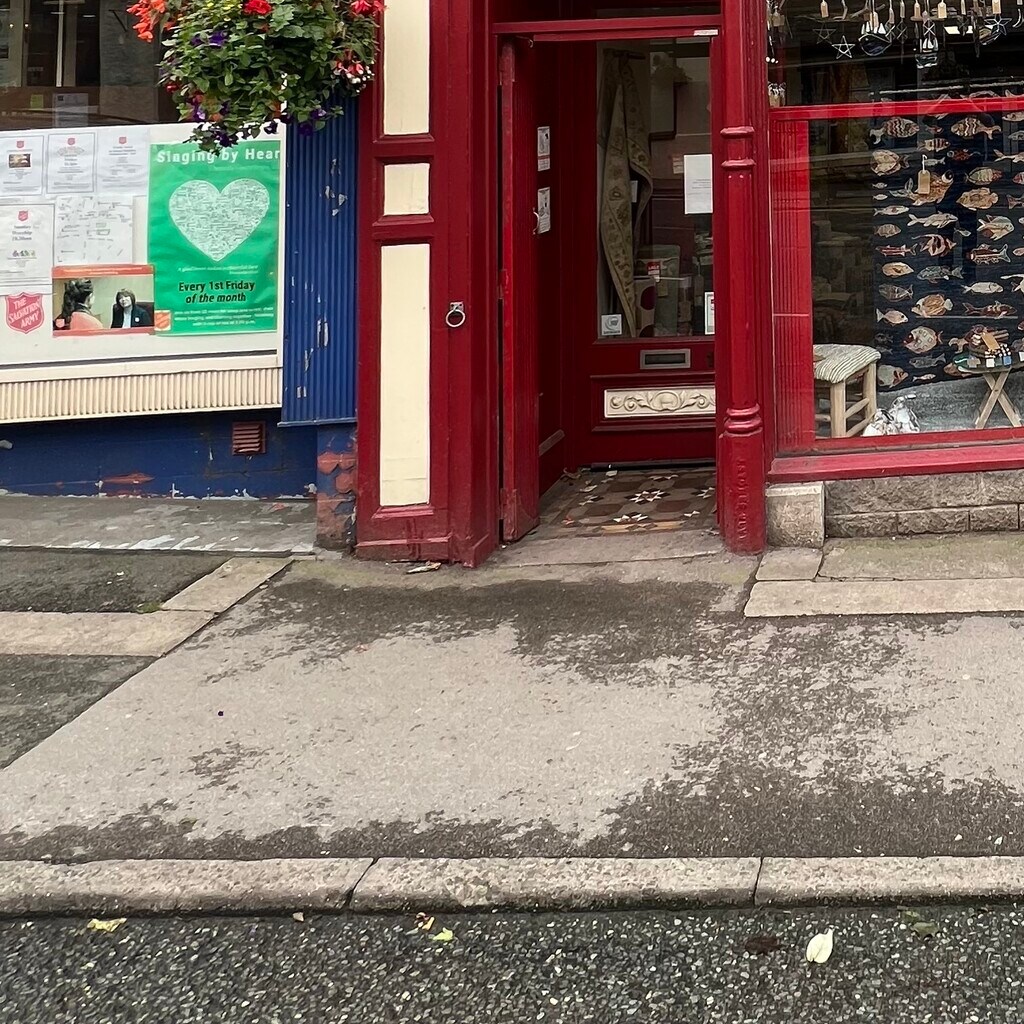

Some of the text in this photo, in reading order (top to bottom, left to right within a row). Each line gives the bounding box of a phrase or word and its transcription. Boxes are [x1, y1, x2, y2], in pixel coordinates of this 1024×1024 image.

[157, 150, 215, 165] Singing
[221, 149, 239, 163] by
[179, 280, 256, 292] Every 1st Friday
[13, 297, 27, 310] THE
[185, 292, 246, 304] of the month
[20, 311, 40, 328] ARMY
